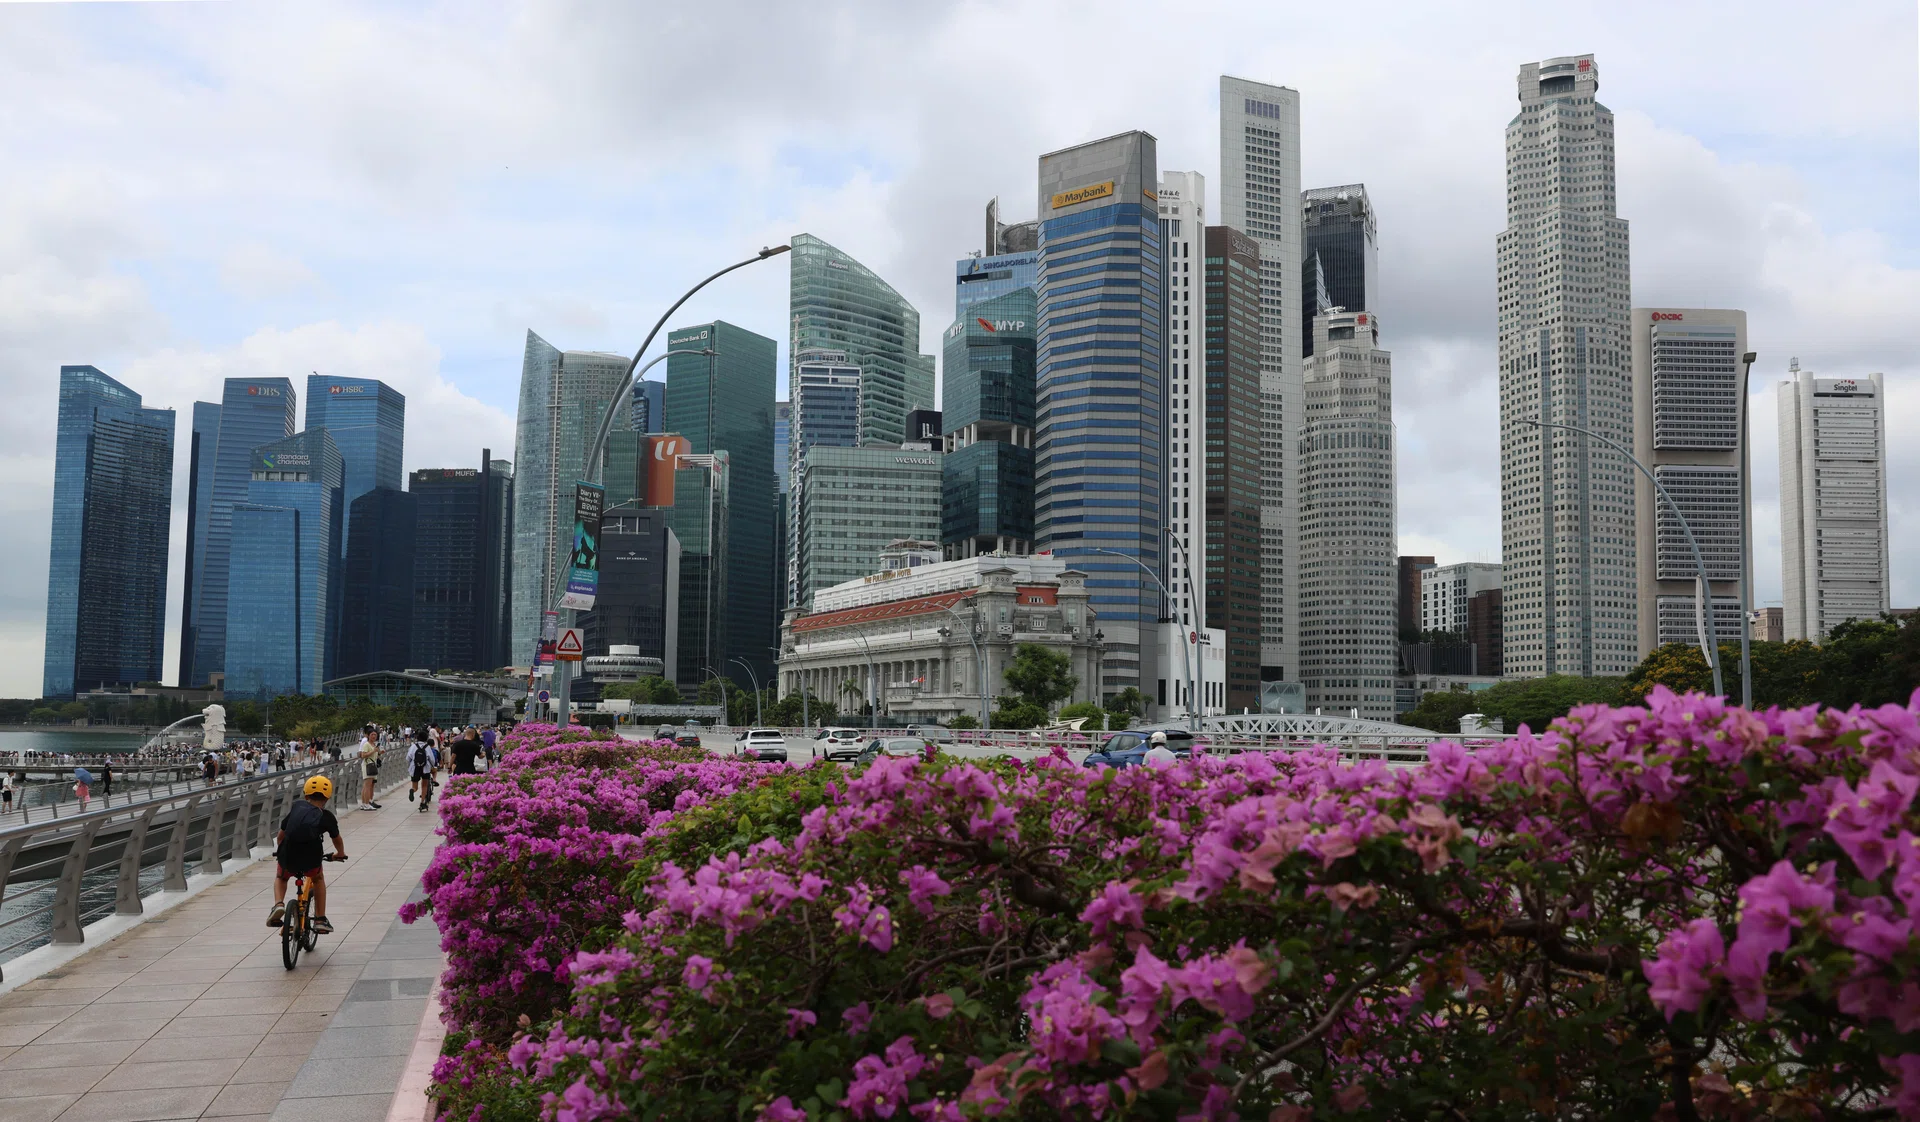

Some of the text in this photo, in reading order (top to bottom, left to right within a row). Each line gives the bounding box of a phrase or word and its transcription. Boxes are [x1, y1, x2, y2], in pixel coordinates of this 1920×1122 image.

[1575, 73, 1594, 81] UOB
[1064, 185, 1106, 202] Maybank
[950, 322, 963, 338] MYP
[996, 320, 1025, 331] MYP
[258, 387, 280, 396] DBS
[1834, 384, 1857, 392] Singtel
[895, 455, 935, 465] wework
[580, 489, 592, 498] Diary
[897, 568, 912, 578] HOTEL
